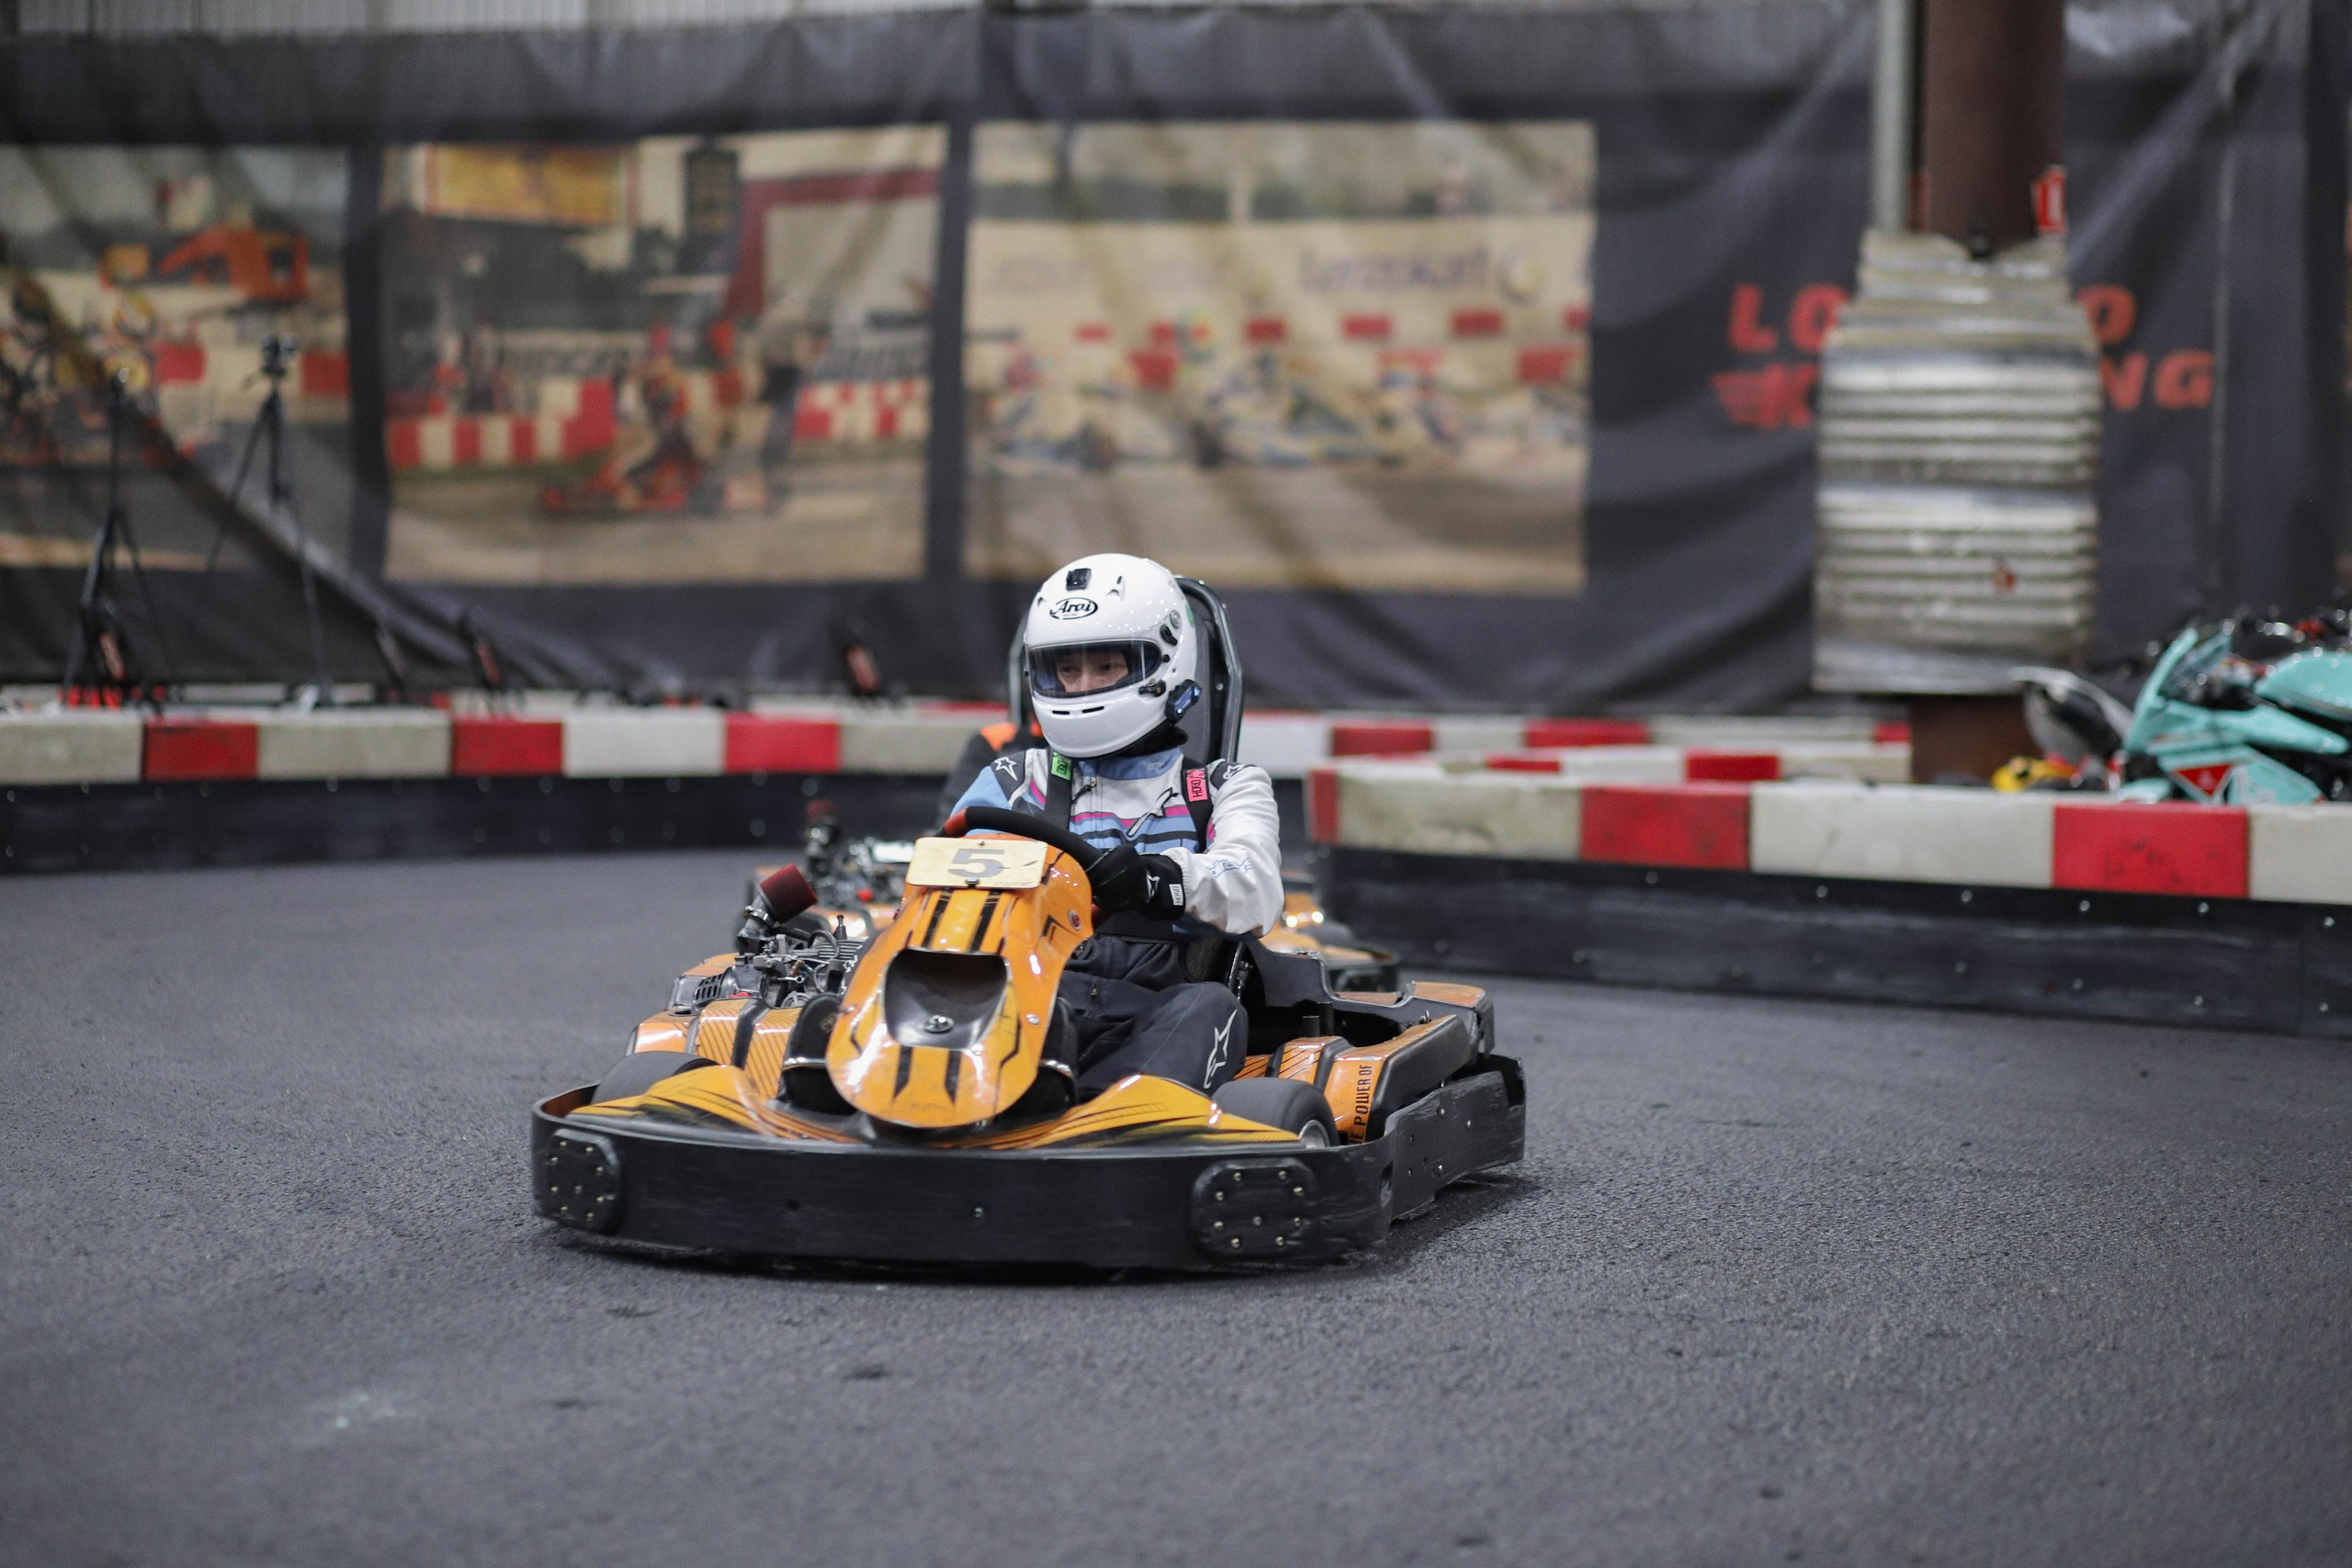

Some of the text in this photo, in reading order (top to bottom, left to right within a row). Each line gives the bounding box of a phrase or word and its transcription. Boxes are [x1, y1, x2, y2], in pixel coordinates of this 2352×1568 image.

[1052, 600, 1091, 615] Arai
[947, 848, 1005, 878] 5
[1358, 1064, 1373, 1077] OF
[1354, 1078, 1372, 1126] POWER
